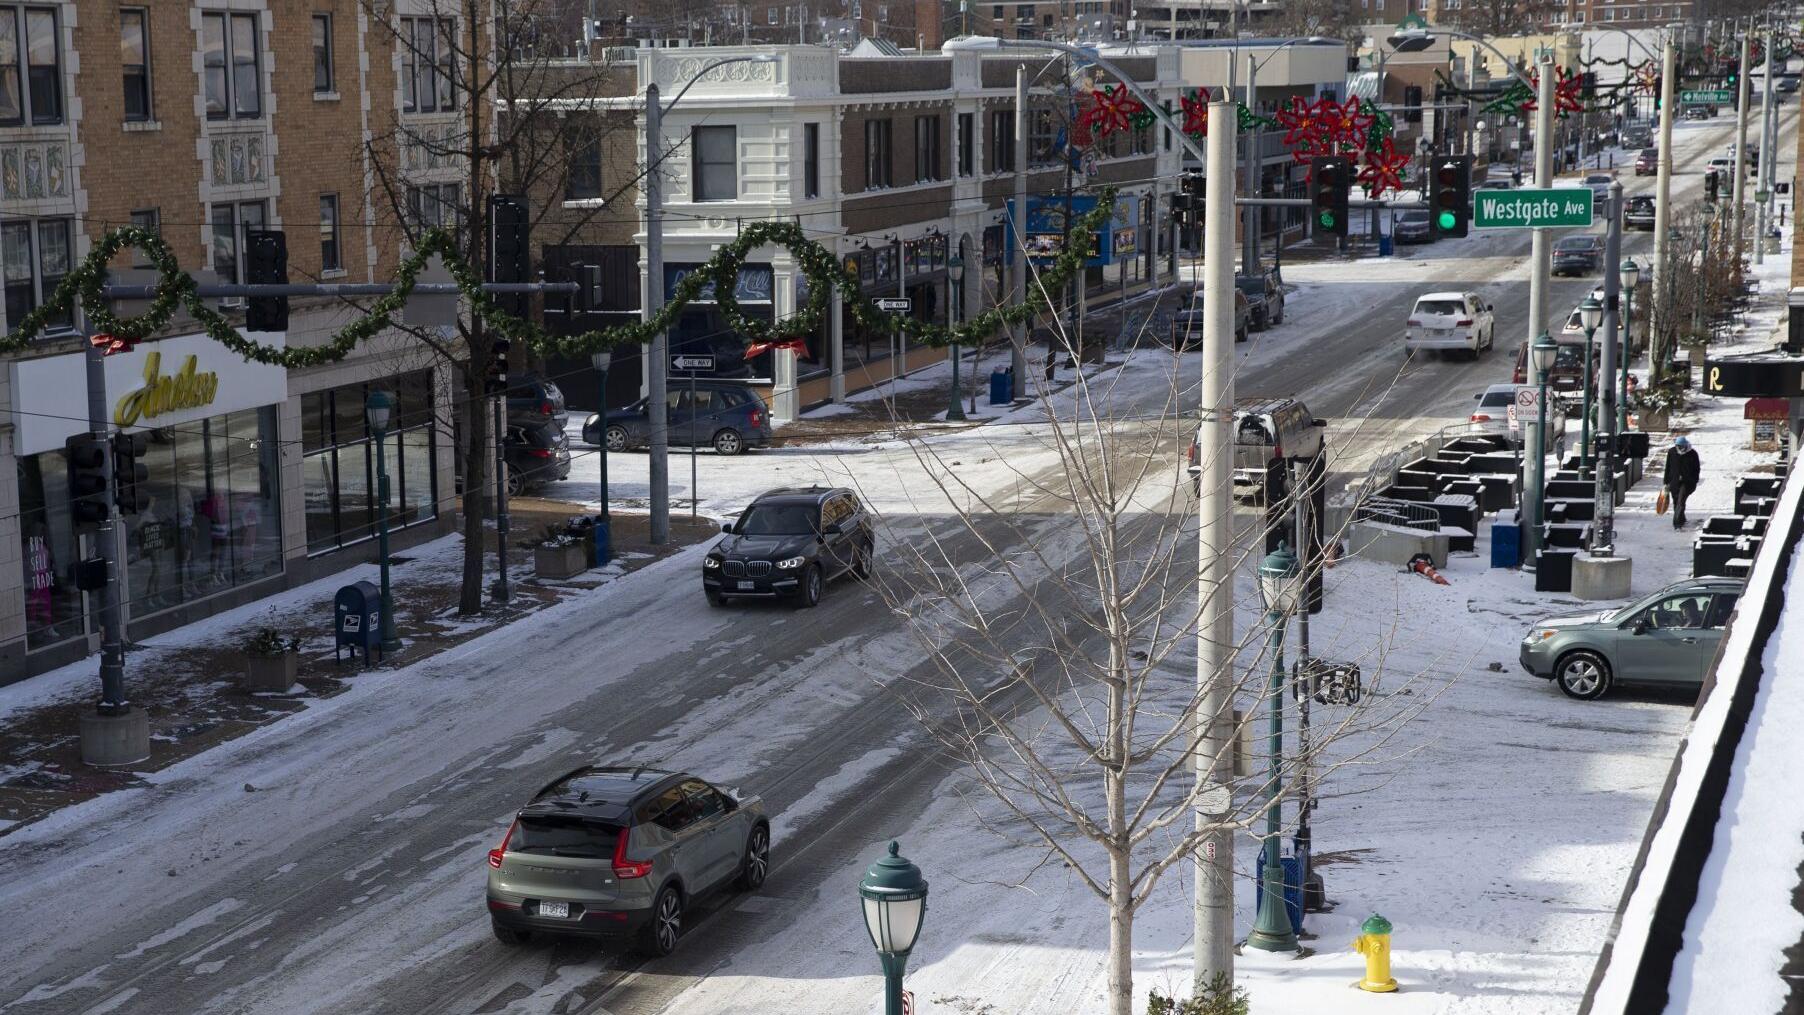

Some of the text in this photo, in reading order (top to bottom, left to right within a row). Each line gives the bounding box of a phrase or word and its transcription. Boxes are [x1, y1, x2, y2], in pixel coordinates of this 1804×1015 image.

[1693, 92, 1718, 101] Melville
[1482, 199, 1585, 225] Westgate Ave
[683, 359, 711, 367] ONE WAY
[29, 535, 44, 553] BUY
[30, 553, 47, 571] SELL
[32, 571, 55, 590] TRADE
